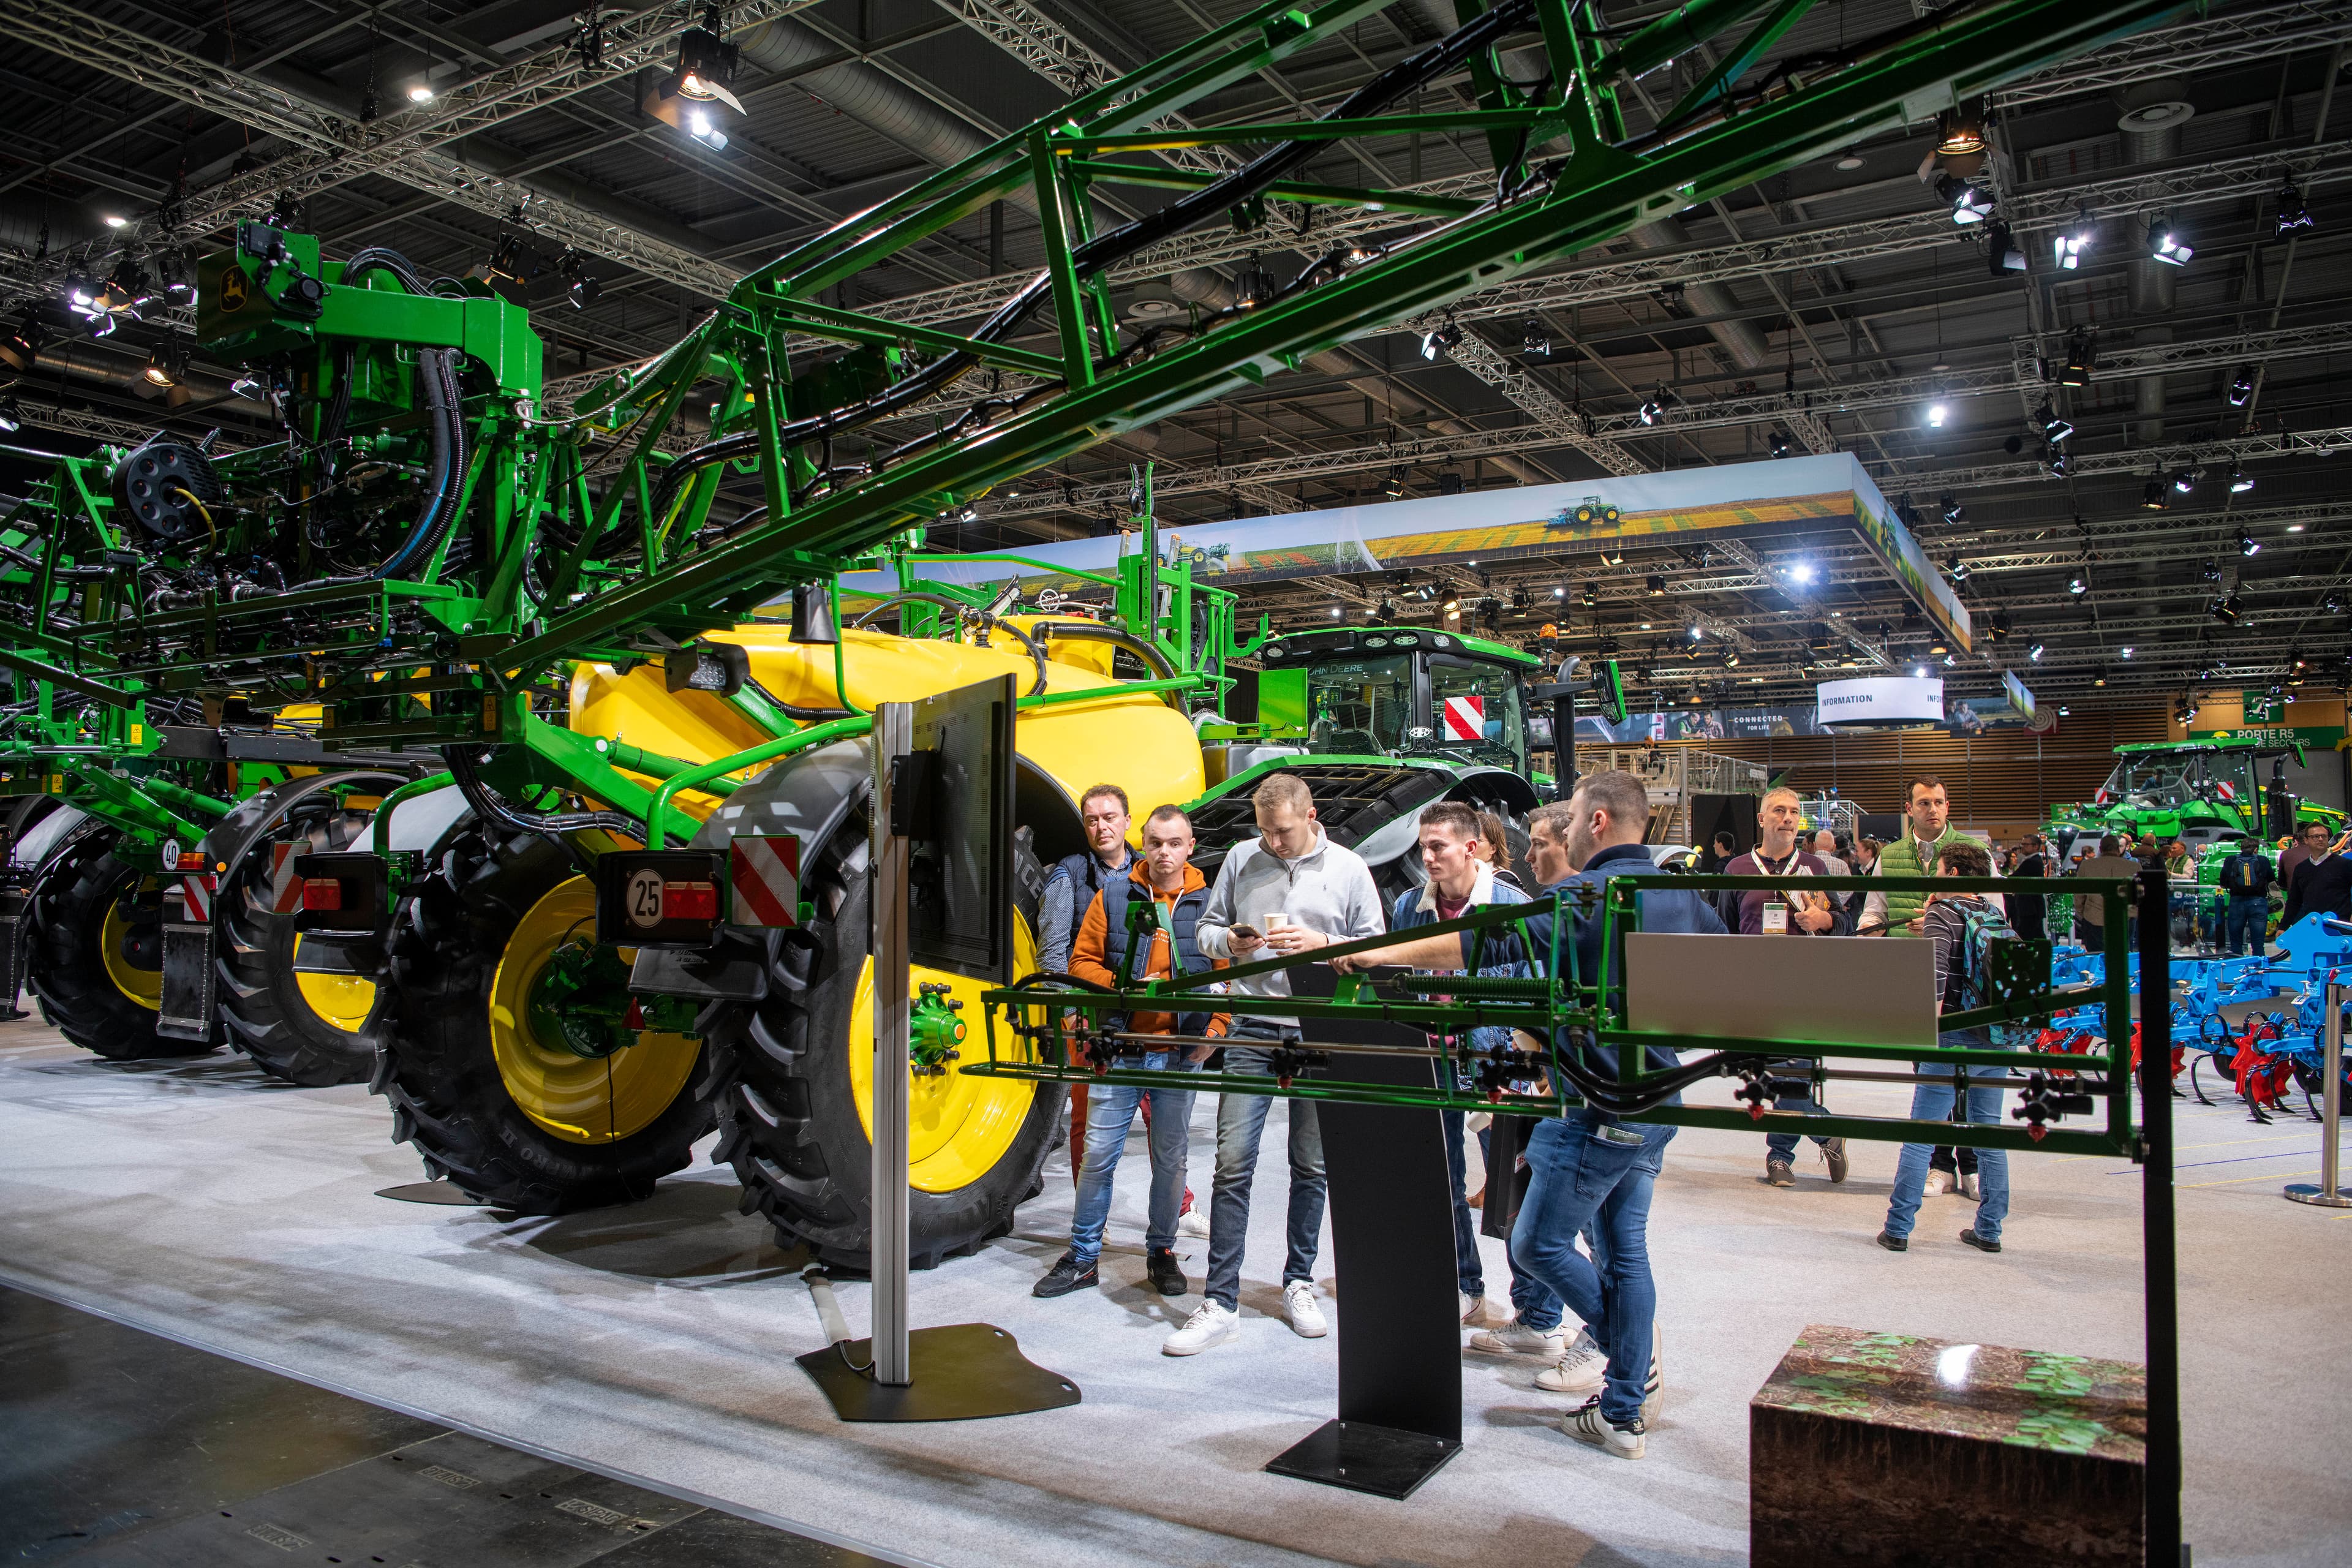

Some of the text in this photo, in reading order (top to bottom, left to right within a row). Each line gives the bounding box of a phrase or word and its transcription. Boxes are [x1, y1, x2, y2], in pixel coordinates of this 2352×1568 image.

[1330, 664, 1363, 673] DEERE
[1822, 695, 1872, 706] INFORMATION
[2237, 728, 2294, 739] PORTE R5
[166, 845, 177, 864] 40
[635, 880, 660, 917] 25
